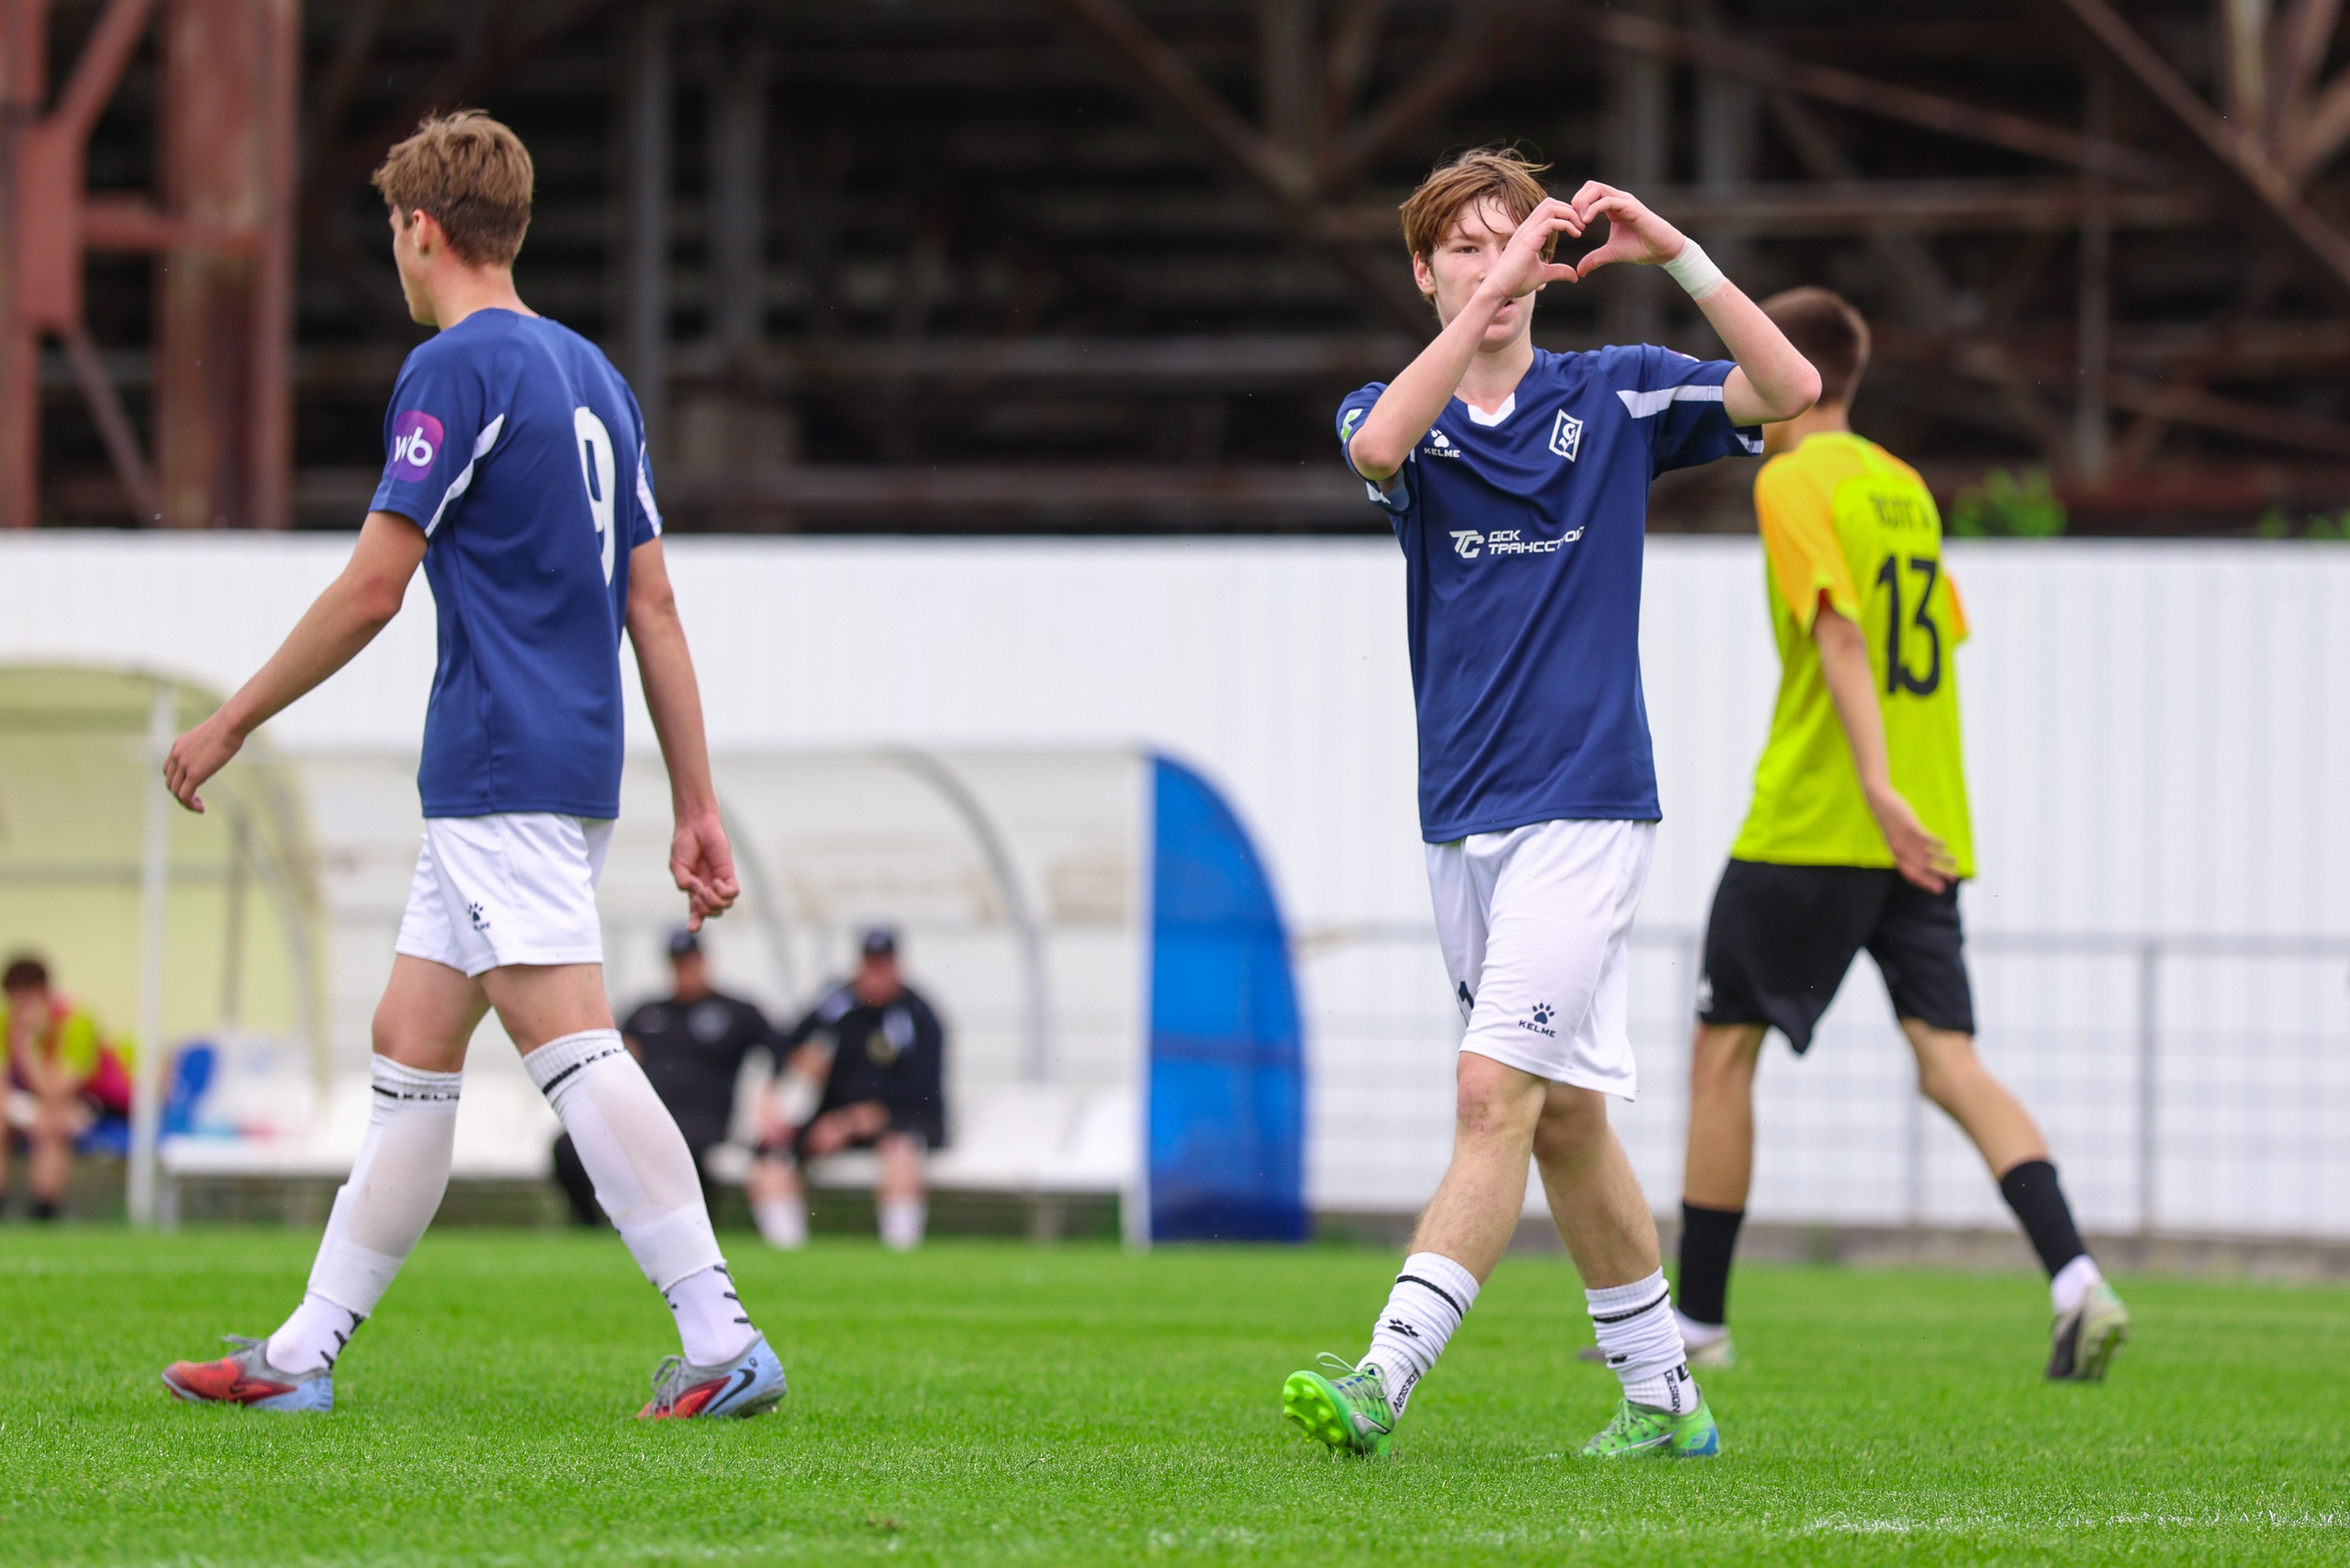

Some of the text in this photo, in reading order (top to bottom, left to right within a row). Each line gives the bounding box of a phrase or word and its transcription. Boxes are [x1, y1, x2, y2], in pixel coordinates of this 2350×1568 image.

[1424, 447, 1461, 458] KELME
[574, 406, 616, 588] 9
[1488, 529, 1522, 543] ДСК
[1488, 526, 1585, 555] ТРАНССТОЙ
[1877, 554, 1940, 696] 13
[1518, 1020, 1557, 1038] KELME
